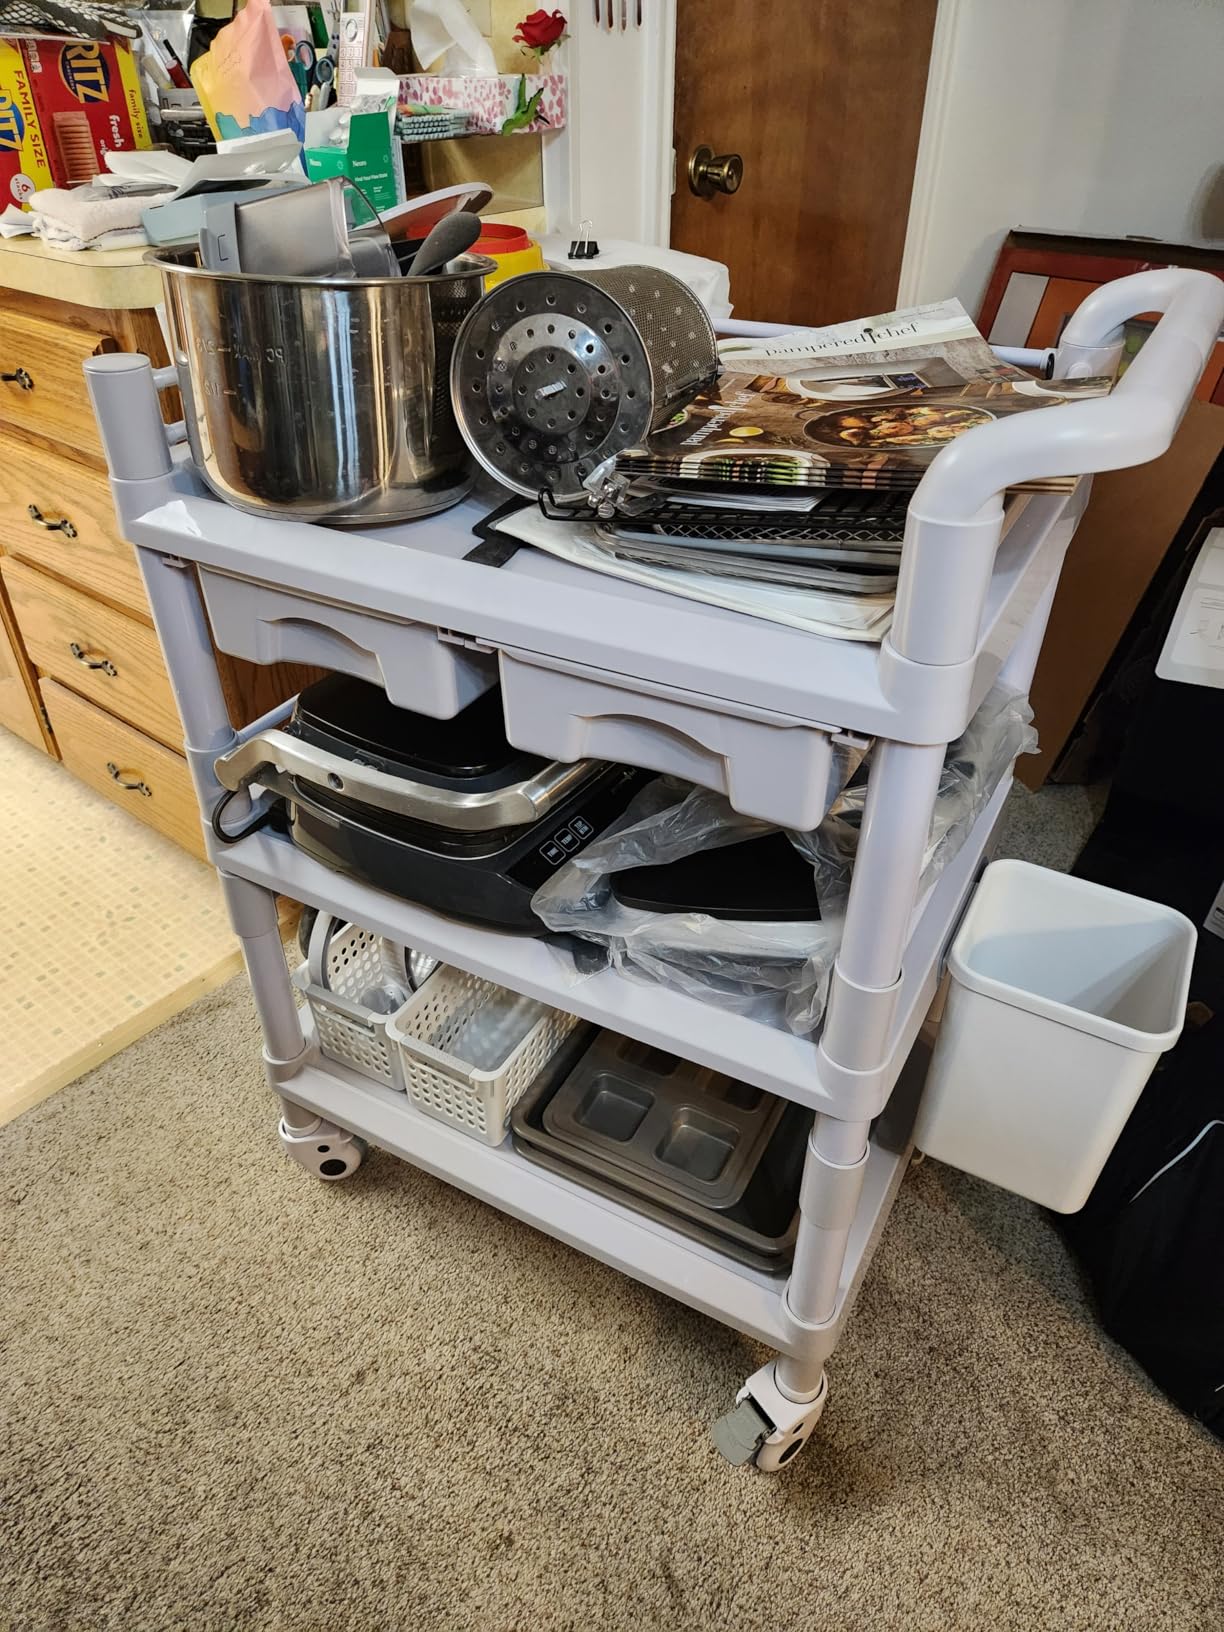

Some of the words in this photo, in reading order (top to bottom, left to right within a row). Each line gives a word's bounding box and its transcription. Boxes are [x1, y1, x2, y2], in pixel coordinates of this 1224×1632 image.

[65, 41, 110, 104] RITZ
[14, 70, 36, 129] FAMILY
[30, 134, 46, 168] SIZE
[128, 89, 140, 120] family
[109, 114, 125, 148] fresh
[14, 178, 24, 200] stacks
[21, 183, 32, 193] 6
[765, 333, 866, 357] pampered
[877, 321, 919, 340] chef
[680, 409, 737, 446] pampered
